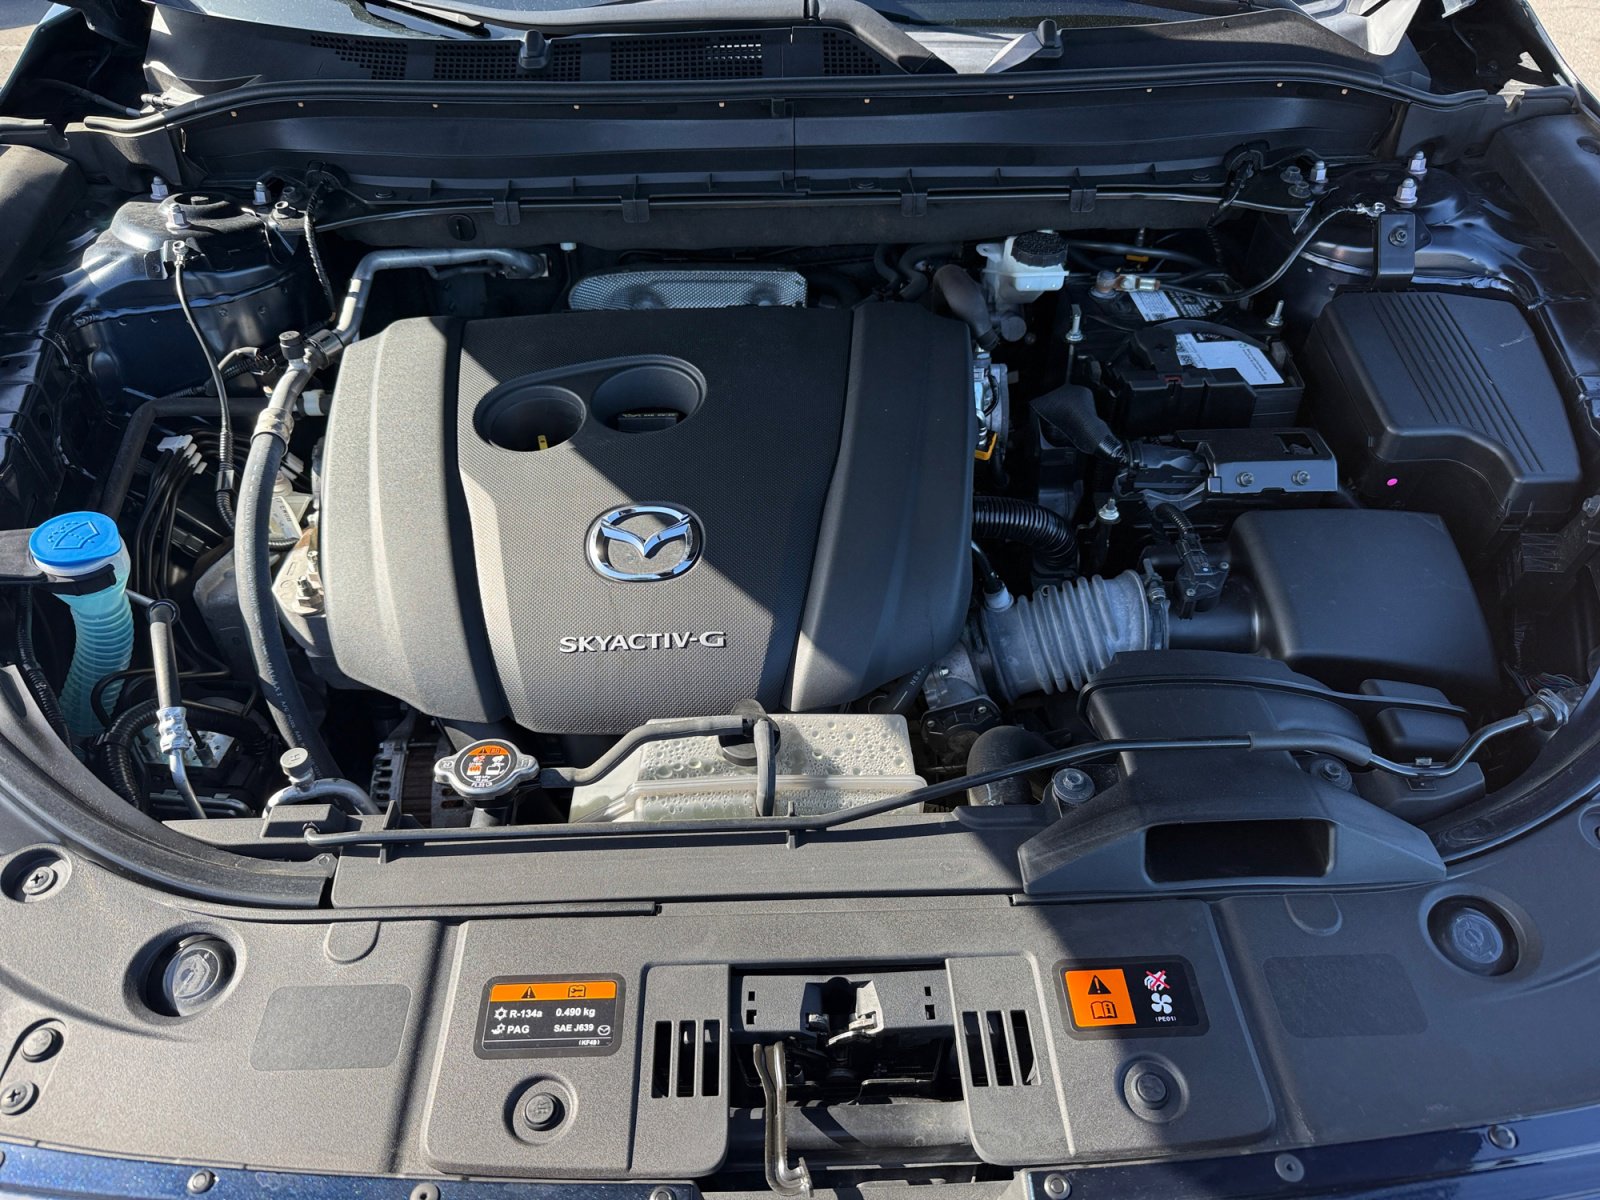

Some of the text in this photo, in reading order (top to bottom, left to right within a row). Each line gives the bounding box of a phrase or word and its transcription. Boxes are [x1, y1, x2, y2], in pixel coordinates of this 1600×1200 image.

[559, 631, 727, 653] SKYACTIV-G
[509, 1007, 596, 1018] R-134a 0.490 kg
[507, 1024, 594, 1034] PAG SAE J639
